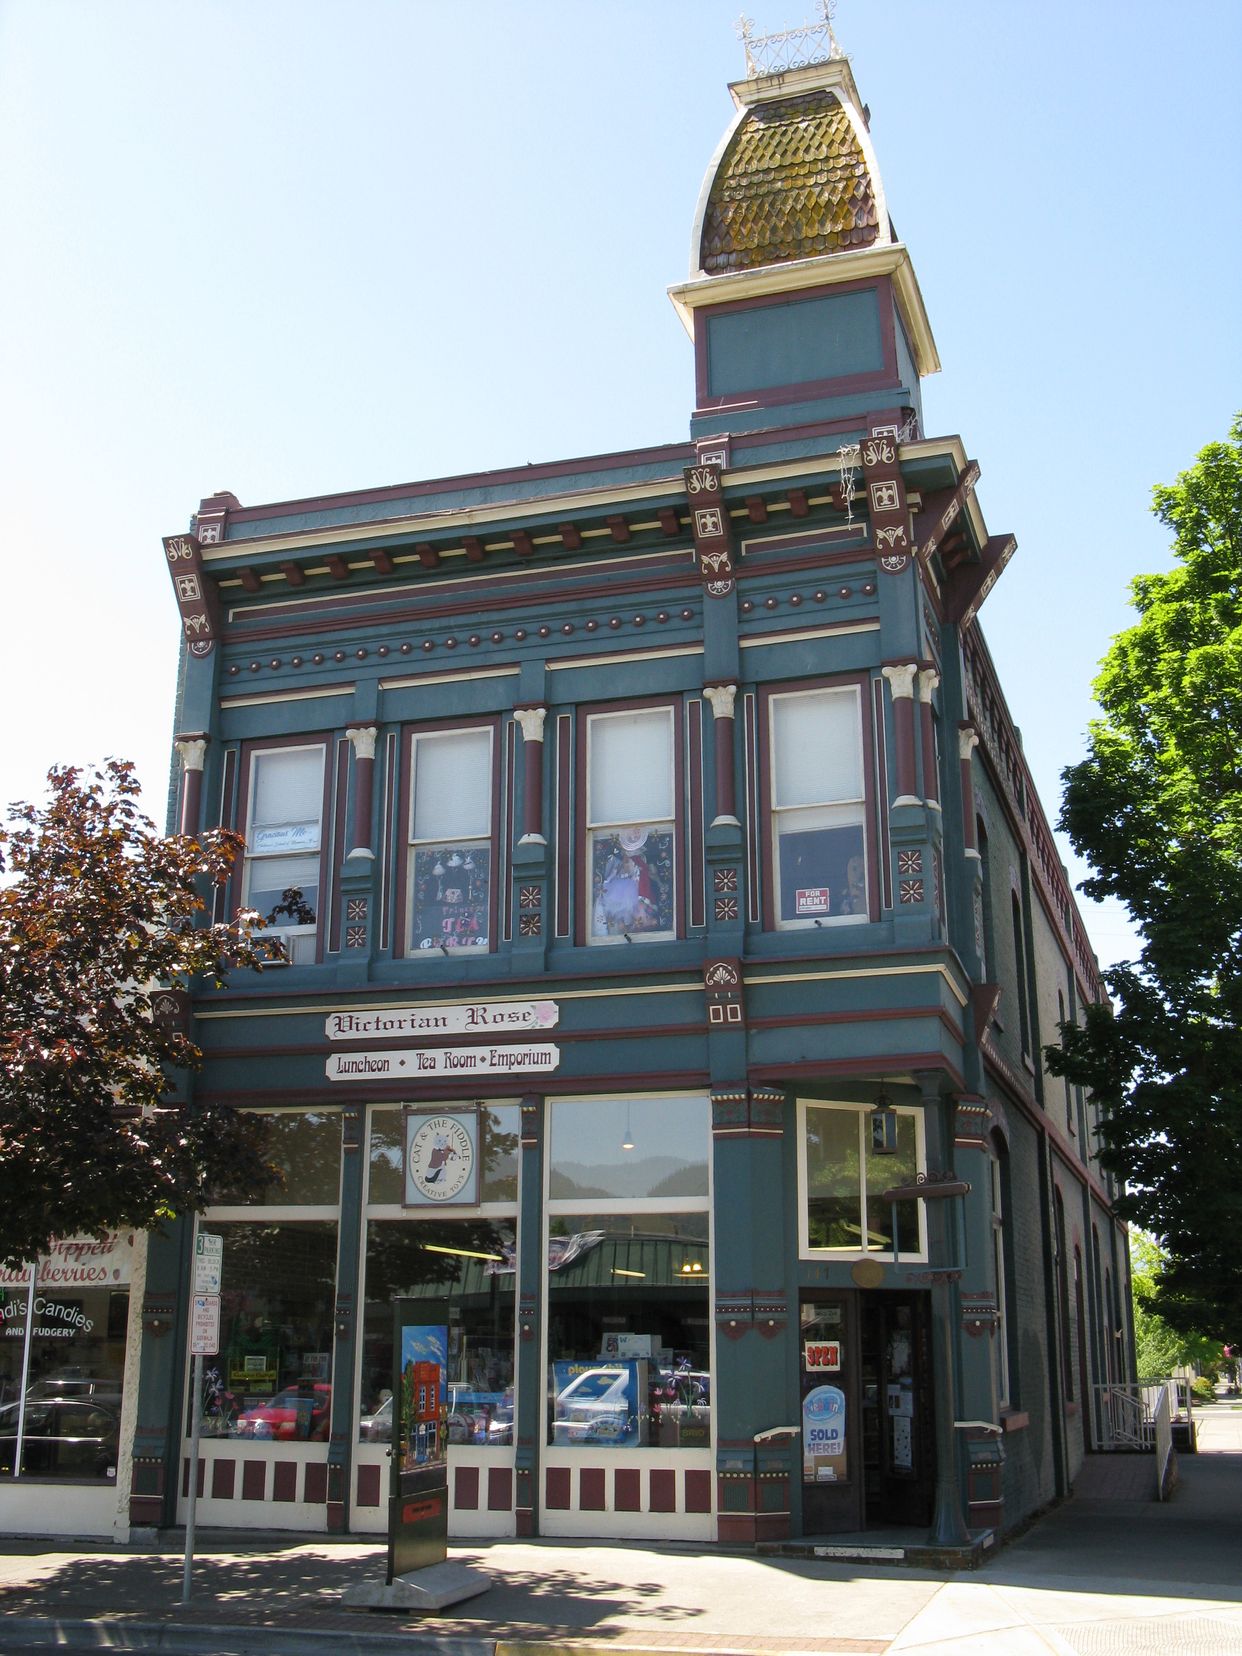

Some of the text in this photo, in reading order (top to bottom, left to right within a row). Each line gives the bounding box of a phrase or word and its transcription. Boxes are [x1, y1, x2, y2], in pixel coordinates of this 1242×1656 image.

[800, 896, 826, 905] RENT
[333, 1006, 532, 1037] Victorian Rose
[336, 1048, 551, 1074] Luncheon Tea Room Emporium
[412, 1143, 422, 1164] CAT
[427, 1119, 447, 1131] THE
[450, 1123, 470, 1162] FIDDLE
[417, 1175, 465, 1198] CREATIVE TOYS
[33, 1297, 94, 1332] Candies
[5, 1327, 76, 1337] AND FUDGERY
[807, 1345, 838, 1366] OPEN
[810, 1429, 838, 1441] SOLD
[808, 1442, 841, 1454] HERE!
